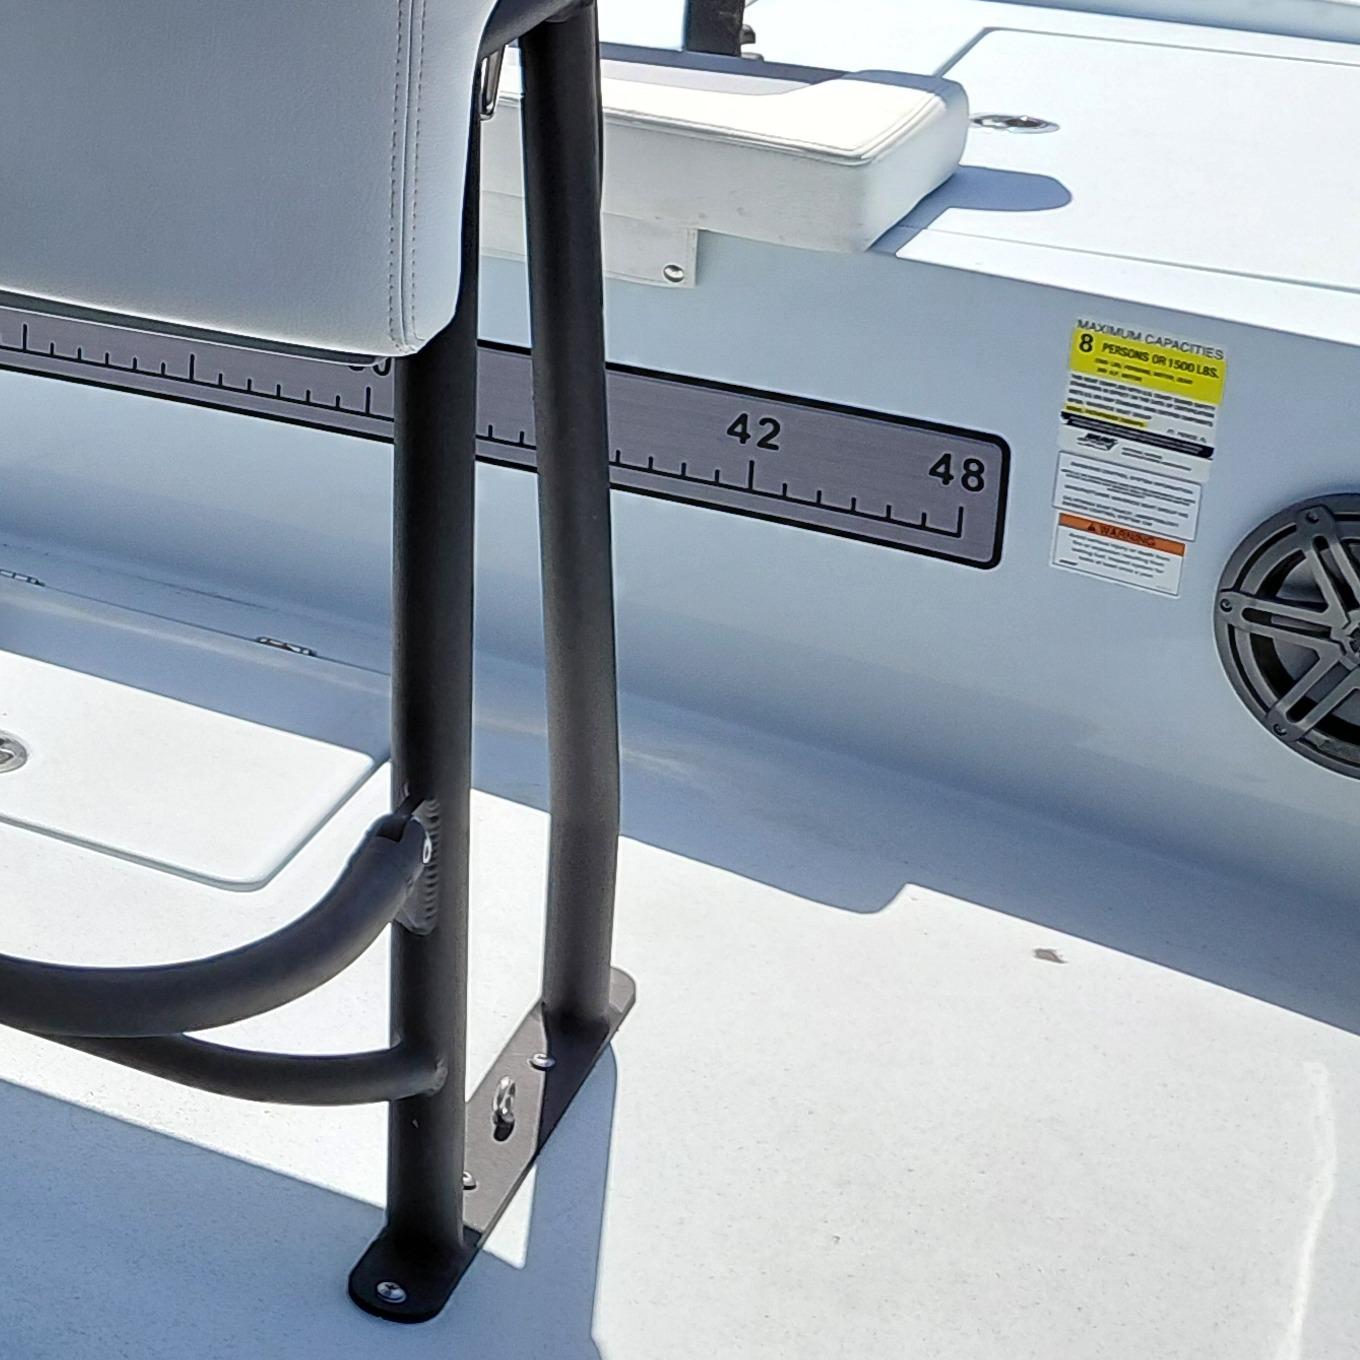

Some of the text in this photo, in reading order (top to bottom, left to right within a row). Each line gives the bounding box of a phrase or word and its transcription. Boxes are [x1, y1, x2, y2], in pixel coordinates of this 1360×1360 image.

[1078, 319, 1224, 361] MAXIMUM CAPACITIES
[1079, 333, 1094, 353] 8
[1101, 342, 1150, 363] PERSONS
[1151, 353, 1167, 365] OR
[1168, 356, 1195, 373] 1500
[726, 412, 781, 451] 42
[928, 453, 985, 493] 48
[1099, 525, 1157, 547] WARNING
